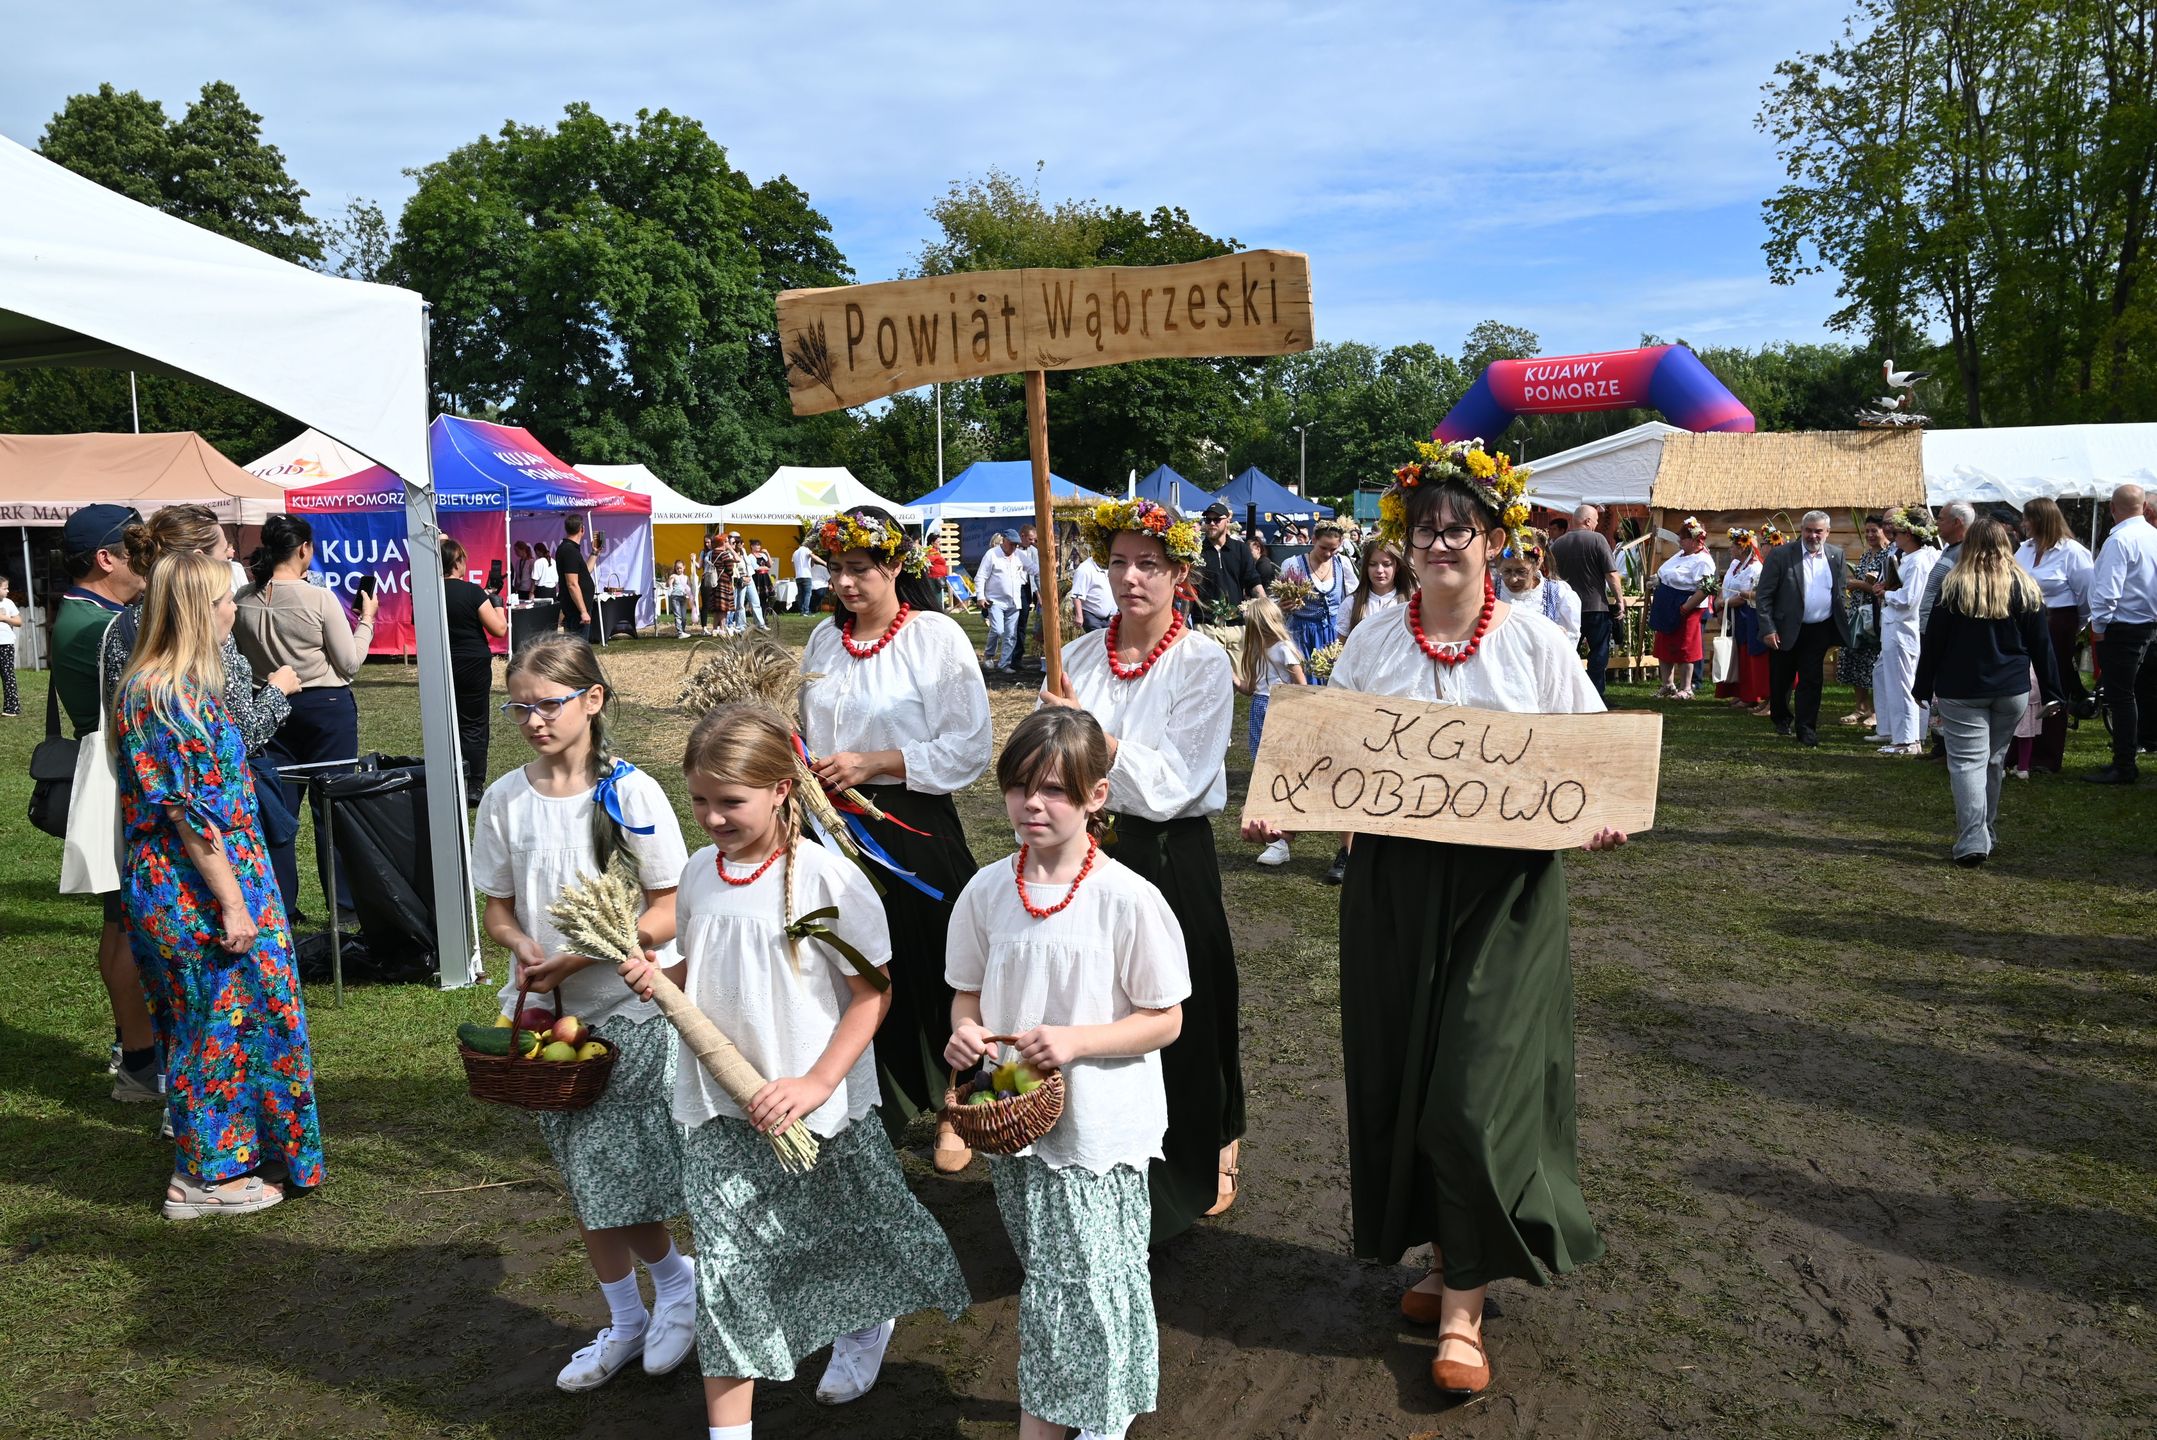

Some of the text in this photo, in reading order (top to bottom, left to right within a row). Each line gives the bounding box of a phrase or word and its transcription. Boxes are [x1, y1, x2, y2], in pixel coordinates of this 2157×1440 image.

[844, 261, 1279, 372] Powiat Wąbrzeski
[1524, 361, 1604, 382] KUJAWY
[1523, 379, 1621, 402] POMORZE
[292, 492, 501, 508] KUJAWY POMORZ BIETUBYC
[0, 505, 82, 520] RK MAT
[731, 512, 800, 520] KUJAWSKO-POMORS
[323, 538, 411, 564] KUJA
[1363, 708, 1533, 766] KGW
[1271, 756, 1587, 824] ŁOBDOWO
